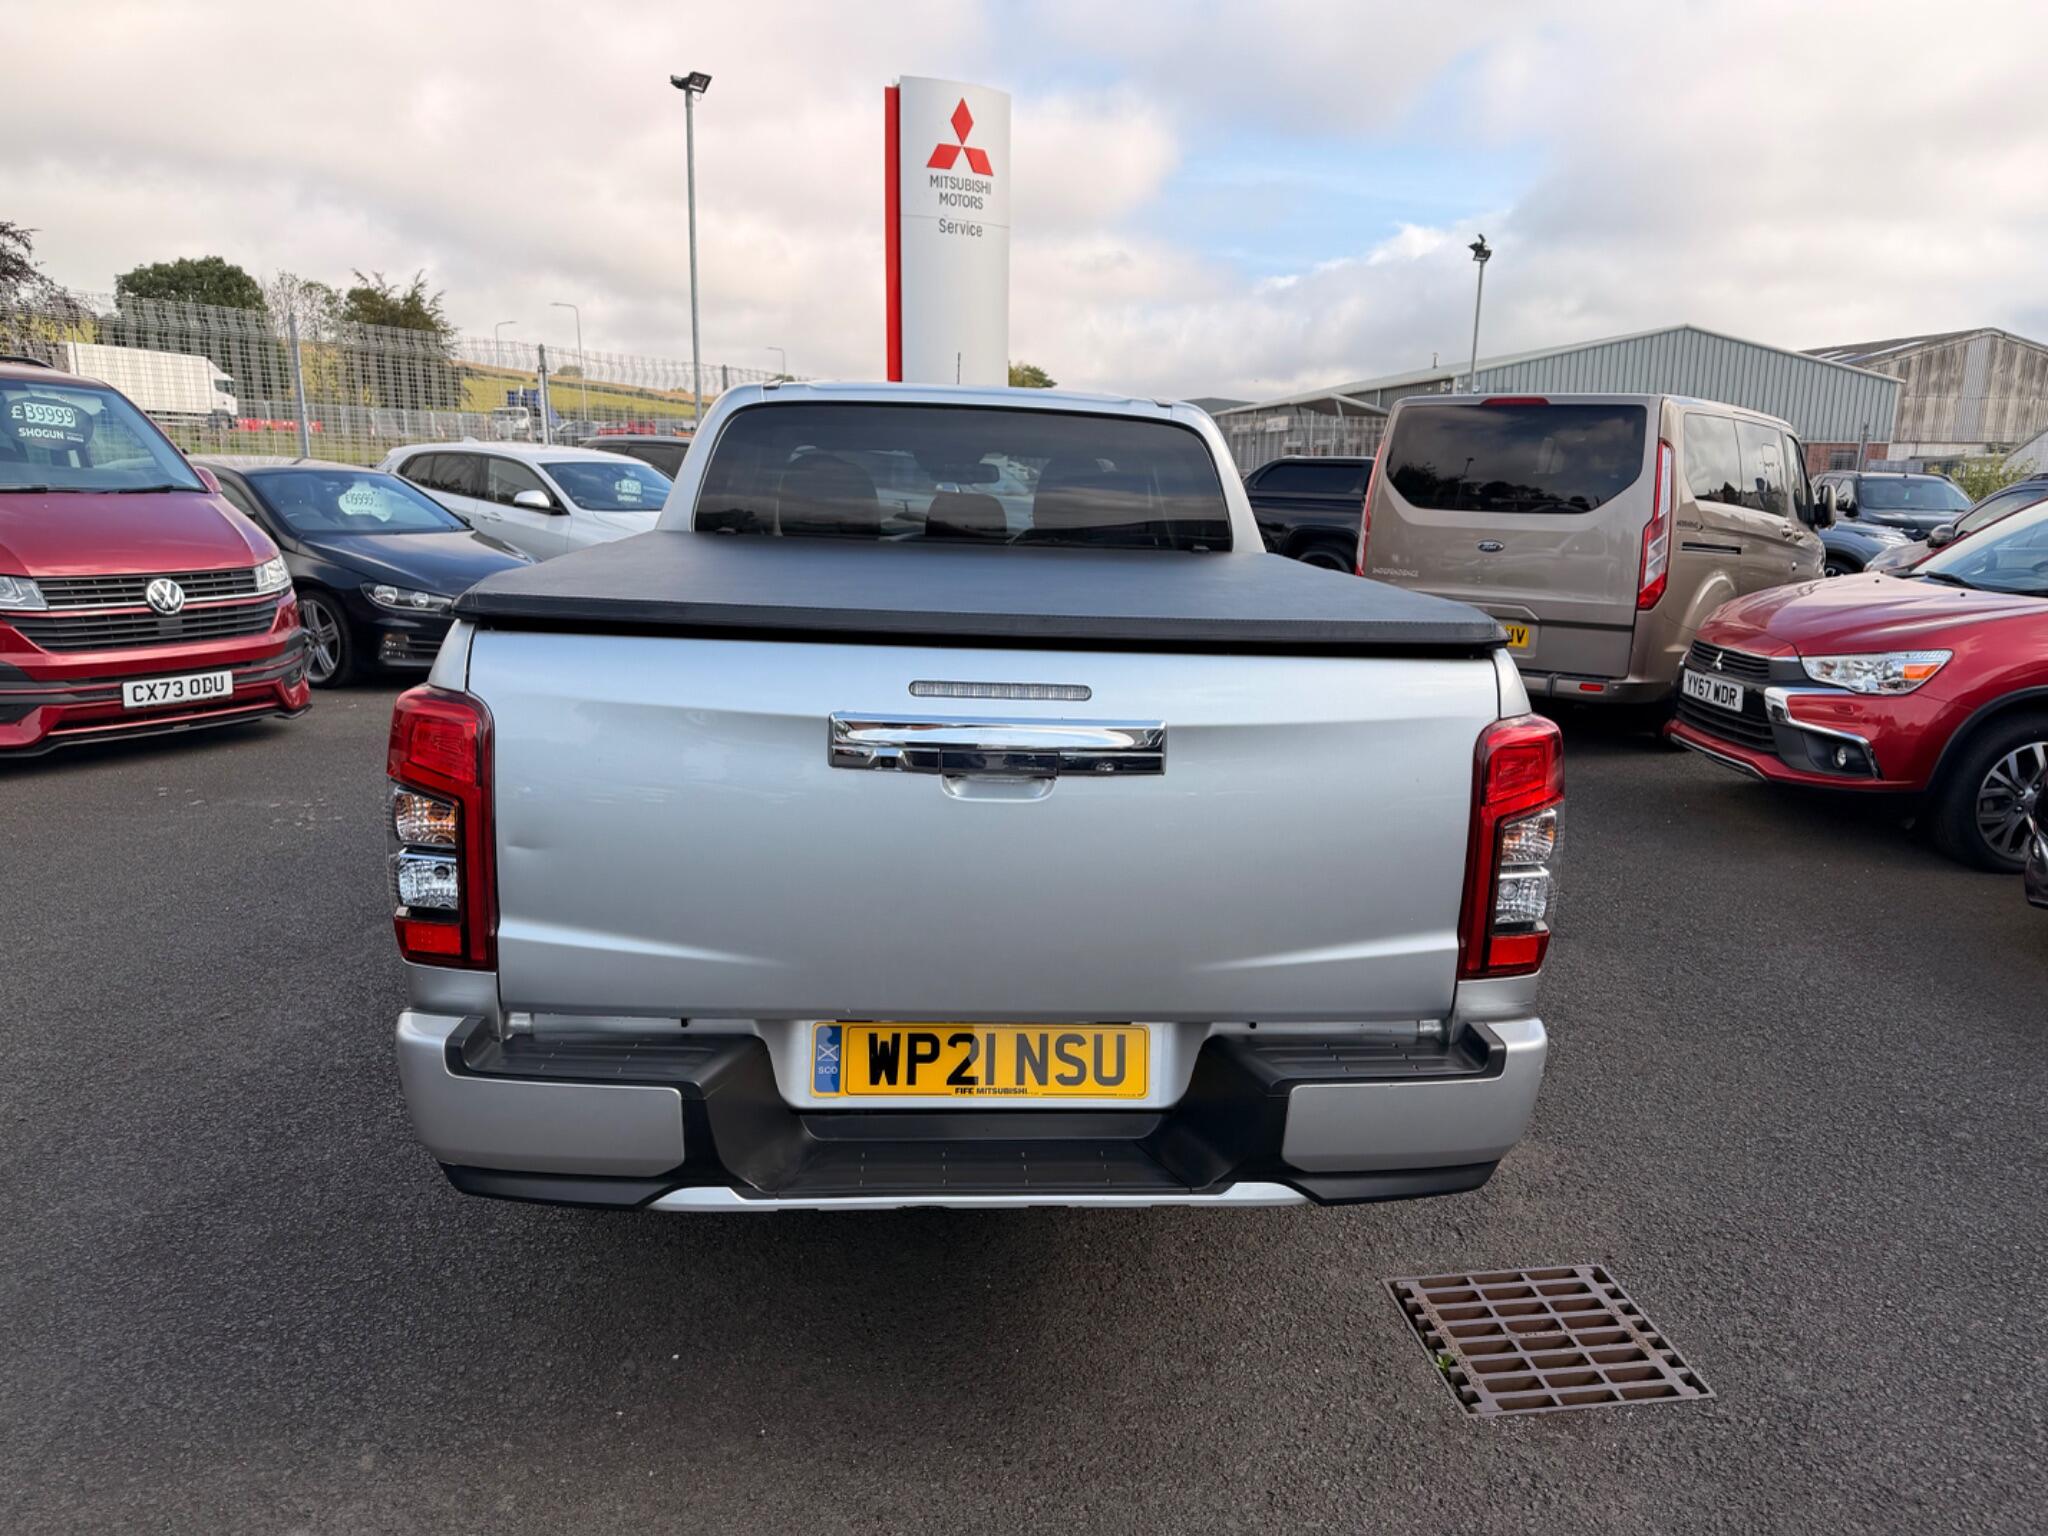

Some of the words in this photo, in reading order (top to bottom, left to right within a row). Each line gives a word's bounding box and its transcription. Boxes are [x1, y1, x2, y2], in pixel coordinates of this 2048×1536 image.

[929, 174, 992, 195] MITSUBISHI
[939, 192, 983, 210] MOTORS
[938, 218, 983, 237] Service
[18, 427, 64, 440] SHOGUN
[132, 680, 184, 703] CX73
[189, 674, 225, 696] ODU
[1687, 673, 1712, 699] YY67
[1713, 682, 1738, 707] WDR
[867, 1032, 997, 1086] WP21
[1015, 1032, 1127, 1087] NSU
[817, 1066, 838, 1075] SCO
[954, 1087, 975, 1096] FIFE
[976, 1087, 1028, 1096] MITSUBISHI
